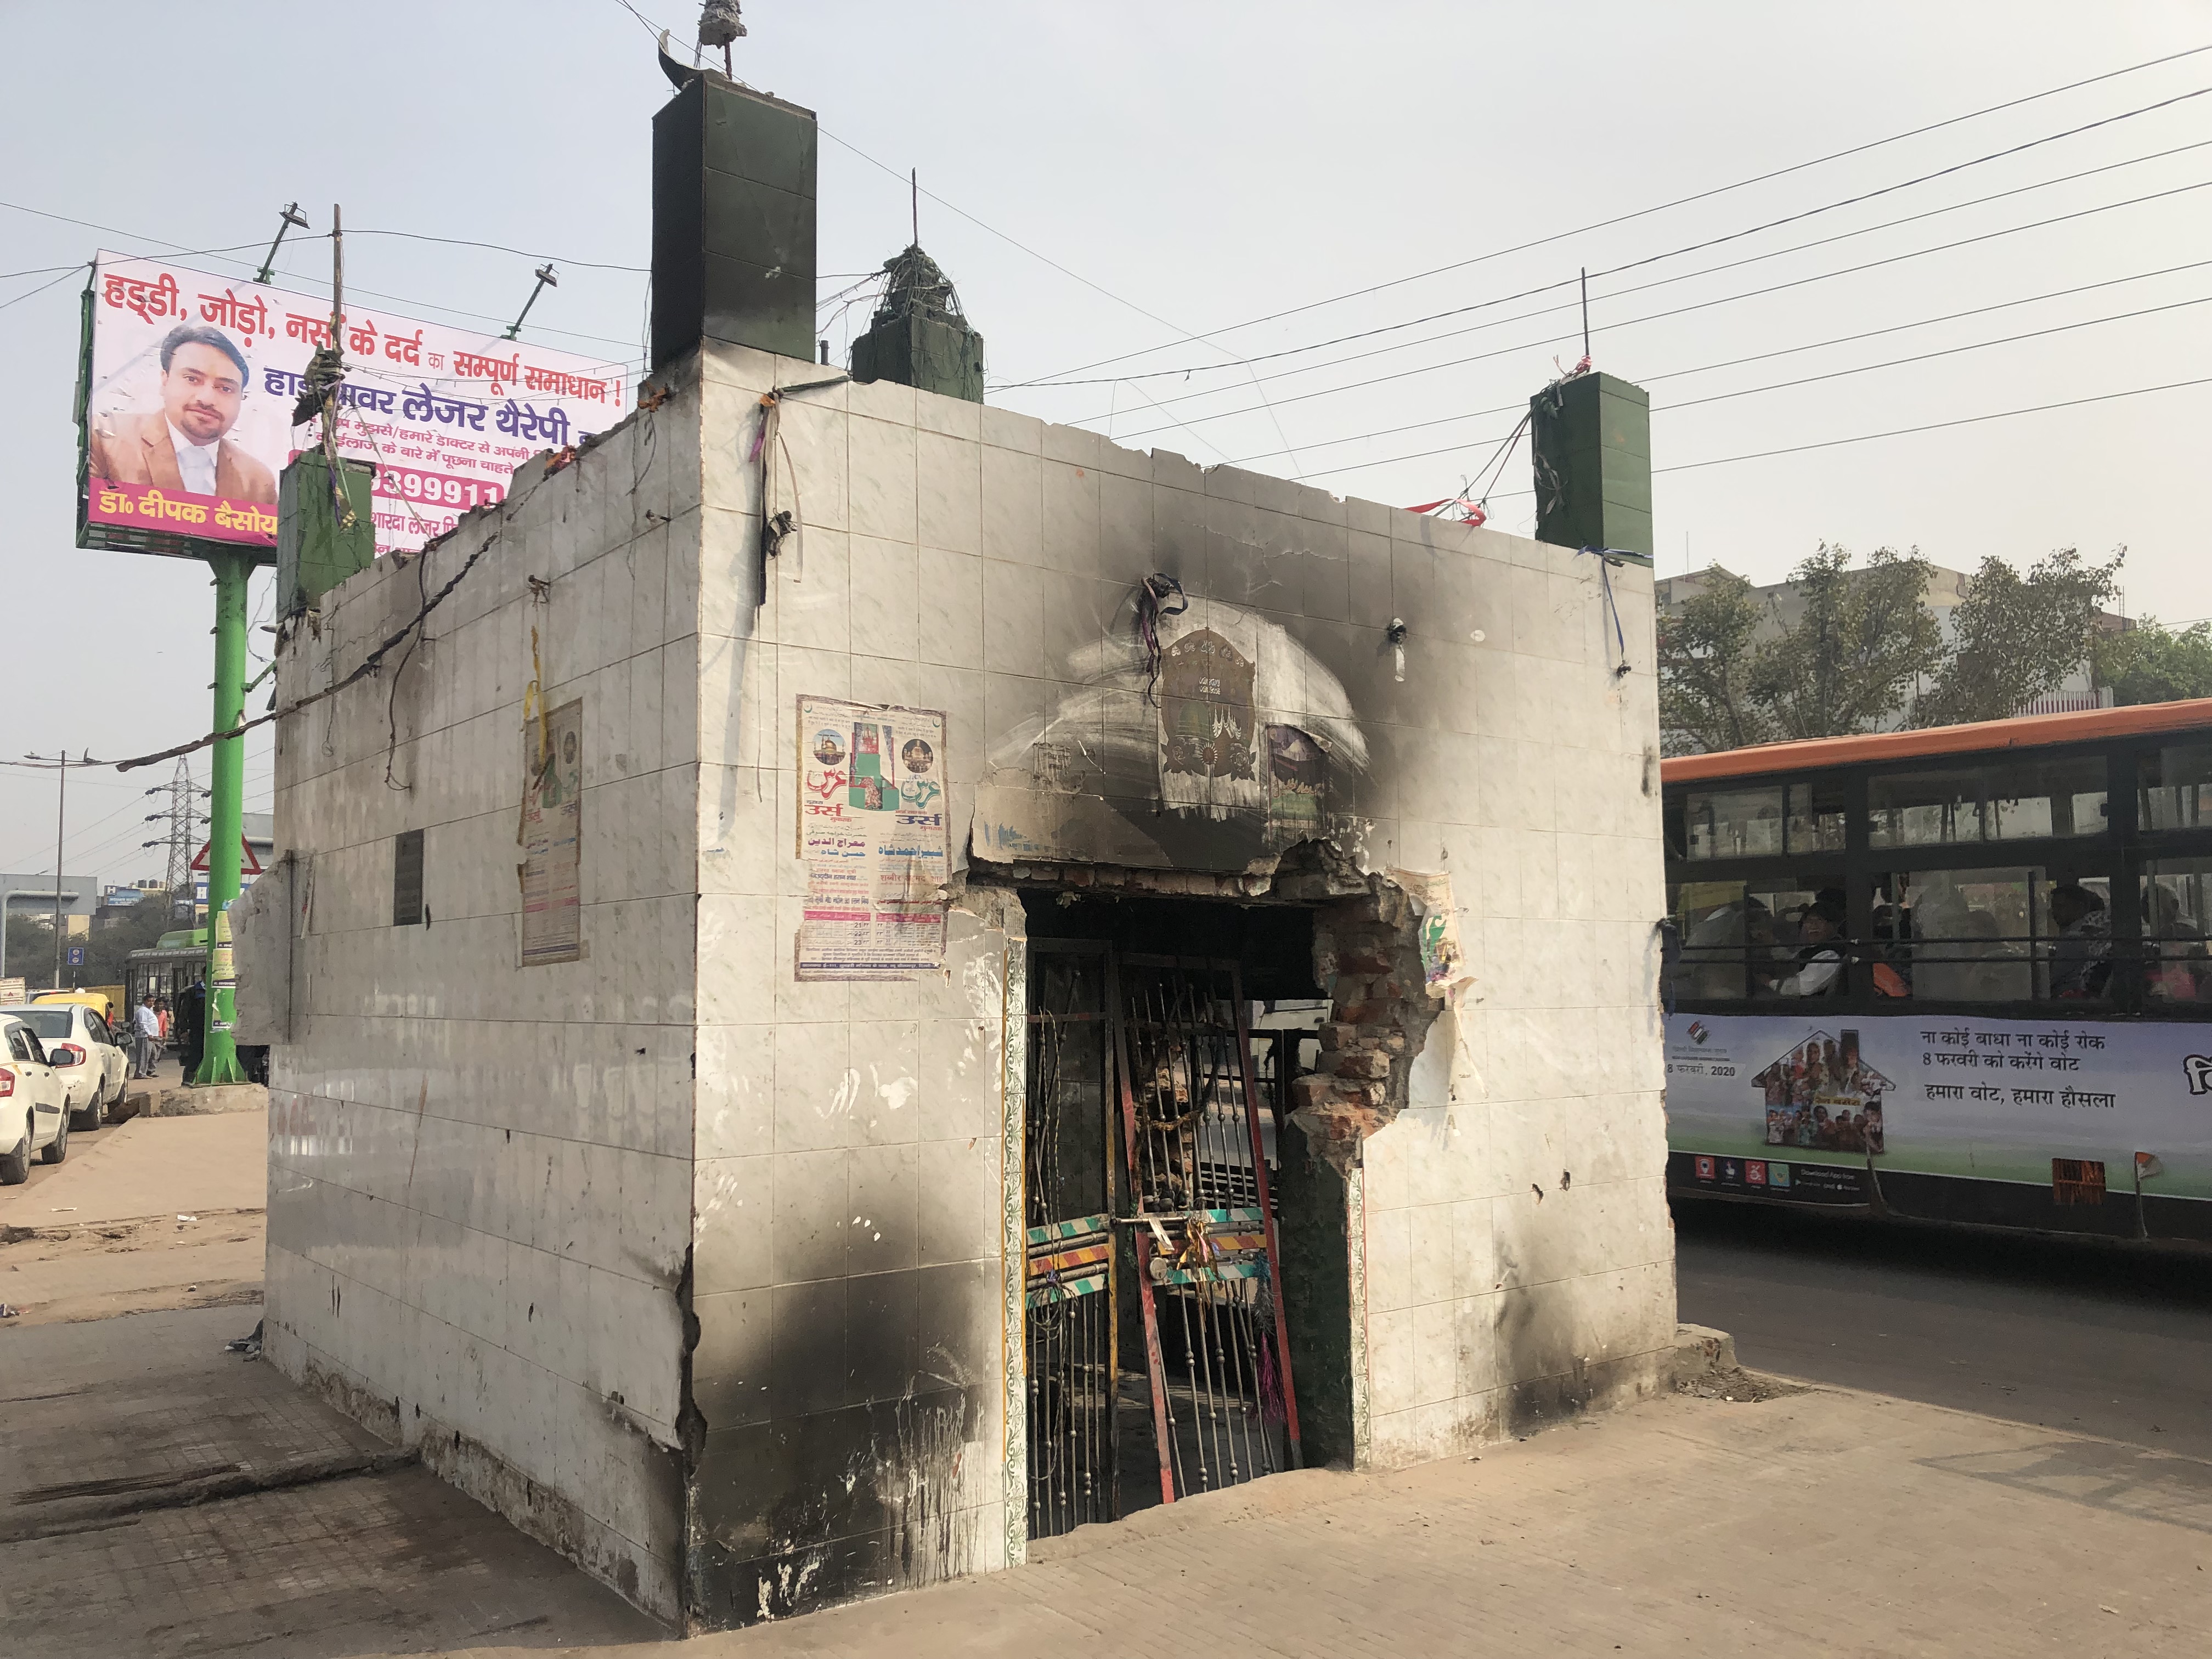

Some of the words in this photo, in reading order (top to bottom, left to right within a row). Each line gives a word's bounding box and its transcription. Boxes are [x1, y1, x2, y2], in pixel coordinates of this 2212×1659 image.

[348, 319, 377, 356] के
[384, 329, 423, 366] दर्द
[428, 352, 445, 370] का
[524, 365, 607, 404] समाधान
[402, 382, 489, 431] लेजर
[495, 398, 572, 445] थैरेपी
[382, 441, 397, 454] के
[400, 445, 424, 459] बारे
[426, 448, 441, 462] में
[442, 453, 477, 470] पूछना
[481, 460, 515, 475] चाहते
[478, 441, 491, 454] से
[494, 445, 530, 460] अपनी
[138, 489, 209, 523] दीपक
[214, 500, 278, 535] बैसोय
[804, 803, 844, 816] उर्स
[895, 813, 943, 826] उर्स
[1920, 1030, 1937, 1045] ना
[1939, 1027, 1971, 1048] कोई
[1974, 1031, 2012, 1047] बाधा
[2015, 1033, 2034, 1047] ना
[2036, 1029, 2070, 1050] कोई
[2074, 1030, 2106, 1050] रोक
[1711, 1065, 1736, 1076] 2020
[1922, 1052, 1932, 1065] 8
[1934, 1049, 1979, 1068] फरवरी
[1982, 1049, 2005, 1068] को
[2008, 1051, 2044, 1070] करेंगे
[2048, 1052, 2081, 1071] वोट
[1924, 1084, 1965, 1101] हमारा
[1968, 1080, 2005, 1105] वोट,
[2011, 1088, 2055, 1107] हमारा
[2059, 1085, 2117, 1109] हौसला
